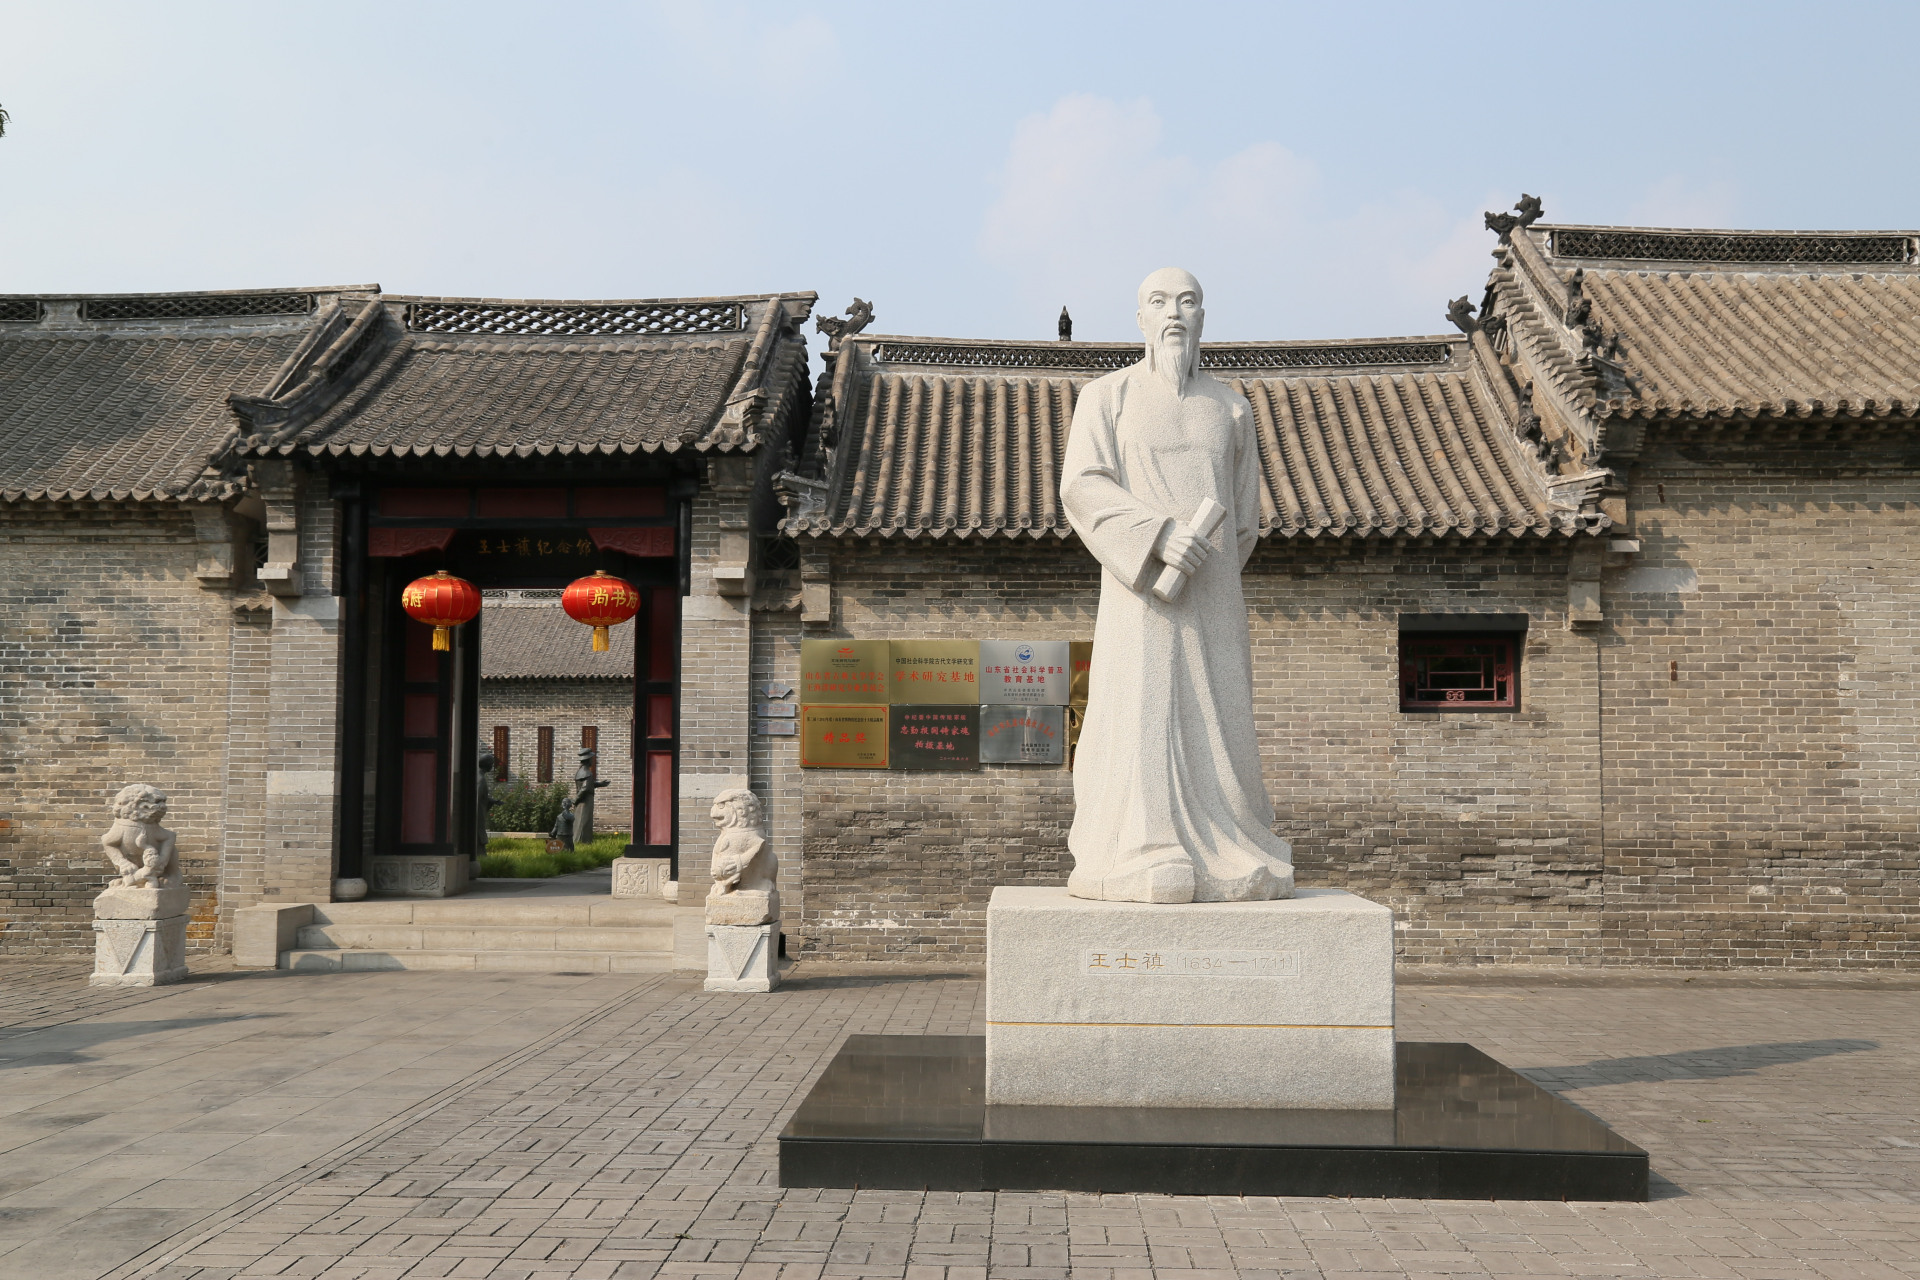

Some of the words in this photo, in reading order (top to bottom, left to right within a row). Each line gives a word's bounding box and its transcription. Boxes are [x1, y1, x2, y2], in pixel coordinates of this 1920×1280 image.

[591, 587, 638, 609] 尚书府
[895, 657, 974, 666] 中国社会科学院古代文学研究室
[985, 666, 1064, 674] 山东省社会科学普及
[805, 671, 885, 681] 山东省古典文学学会
[894, 671, 975, 683] 学术研究基地
[1003, 675, 1045, 683] 教育基地
[822, 731, 868, 745] 精品奖
[914, 740, 955, 751] 拍摄基地
